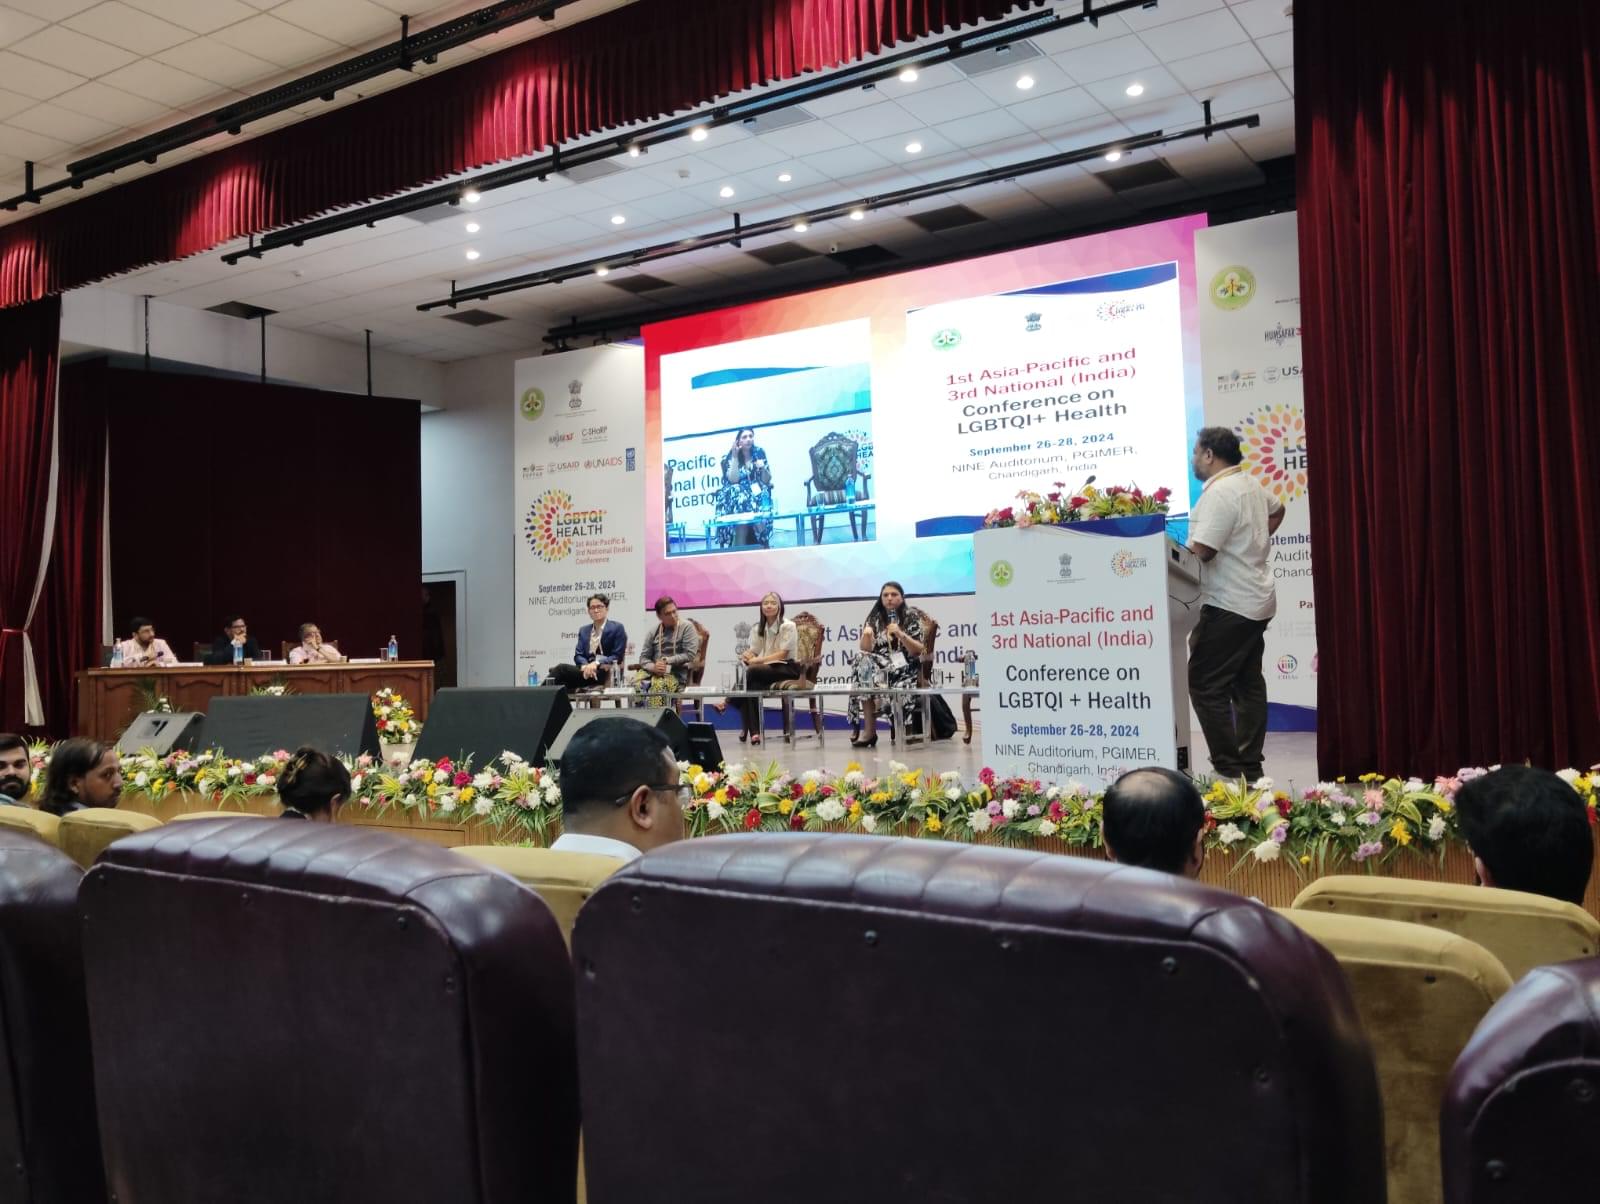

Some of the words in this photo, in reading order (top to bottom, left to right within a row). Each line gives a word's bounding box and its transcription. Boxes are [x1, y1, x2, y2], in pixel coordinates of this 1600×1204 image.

[946, 371, 973, 386] 1st
[979, 355, 1091, 381] Asia-Pacific
[1098, 347, 1137, 364] and
[947, 387, 978, 402] 3rd
[984, 375, 1064, 397] National
[1071, 365, 1137, 386] (India)
[1217, 380, 1255, 392] PEPFAR
[962, 392, 1082, 418] Conference
[1087, 387, 1115, 402] on
[957, 411, 1047, 435] LGBTQI+
[1055, 402, 1128, 424] Health
[969, 443, 1032, 458] September
[1036, 436, 1078, 450] 26-28,
[1082, 432, 1115, 445] 2024
[557, 461, 580, 471] USAID
[592, 457, 623, 469] UNAIDS
[952, 461, 985, 473] NINE
[1066, 462, 1098, 473] India
[674, 476, 696, 492] nal
[556, 525, 603, 538] HEALTH
[586, 538, 621, 547] Asia-Pacific
[587, 546, 613, 556] National
[575, 557, 610, 565] Conference
[538, 583, 573, 594] September
[598, 580, 616, 590] 2024
[528, 595, 548, 606] NINE
[1299, 600, 1313, 609] Pa
[990, 611, 1015, 627] 1st
[1019, 607, 1115, 626] Asia-Pacific
[1121, 605, 1154, 622] and
[991, 632, 1018, 649] 3rd
[1023, 631, 1091, 649] National
[1097, 629, 1154, 650] (India)
[1006, 664, 1110, 682] Conference
[1116, 667, 1141, 682] on
[999, 692, 1063, 712] LGBTQI
[1087, 691, 1151, 710] Health
[1010, 723, 1067, 739] September
[1070, 723, 1107, 739] 26-28,
[1110, 724, 1140, 738] 2024
[995, 744, 1025, 757] NINE
[1028, 744, 1098, 760] Auditorium,
[1102, 746, 1160, 762] PGIMER,
[1028, 762, 1094, 777] Chandigarh,
